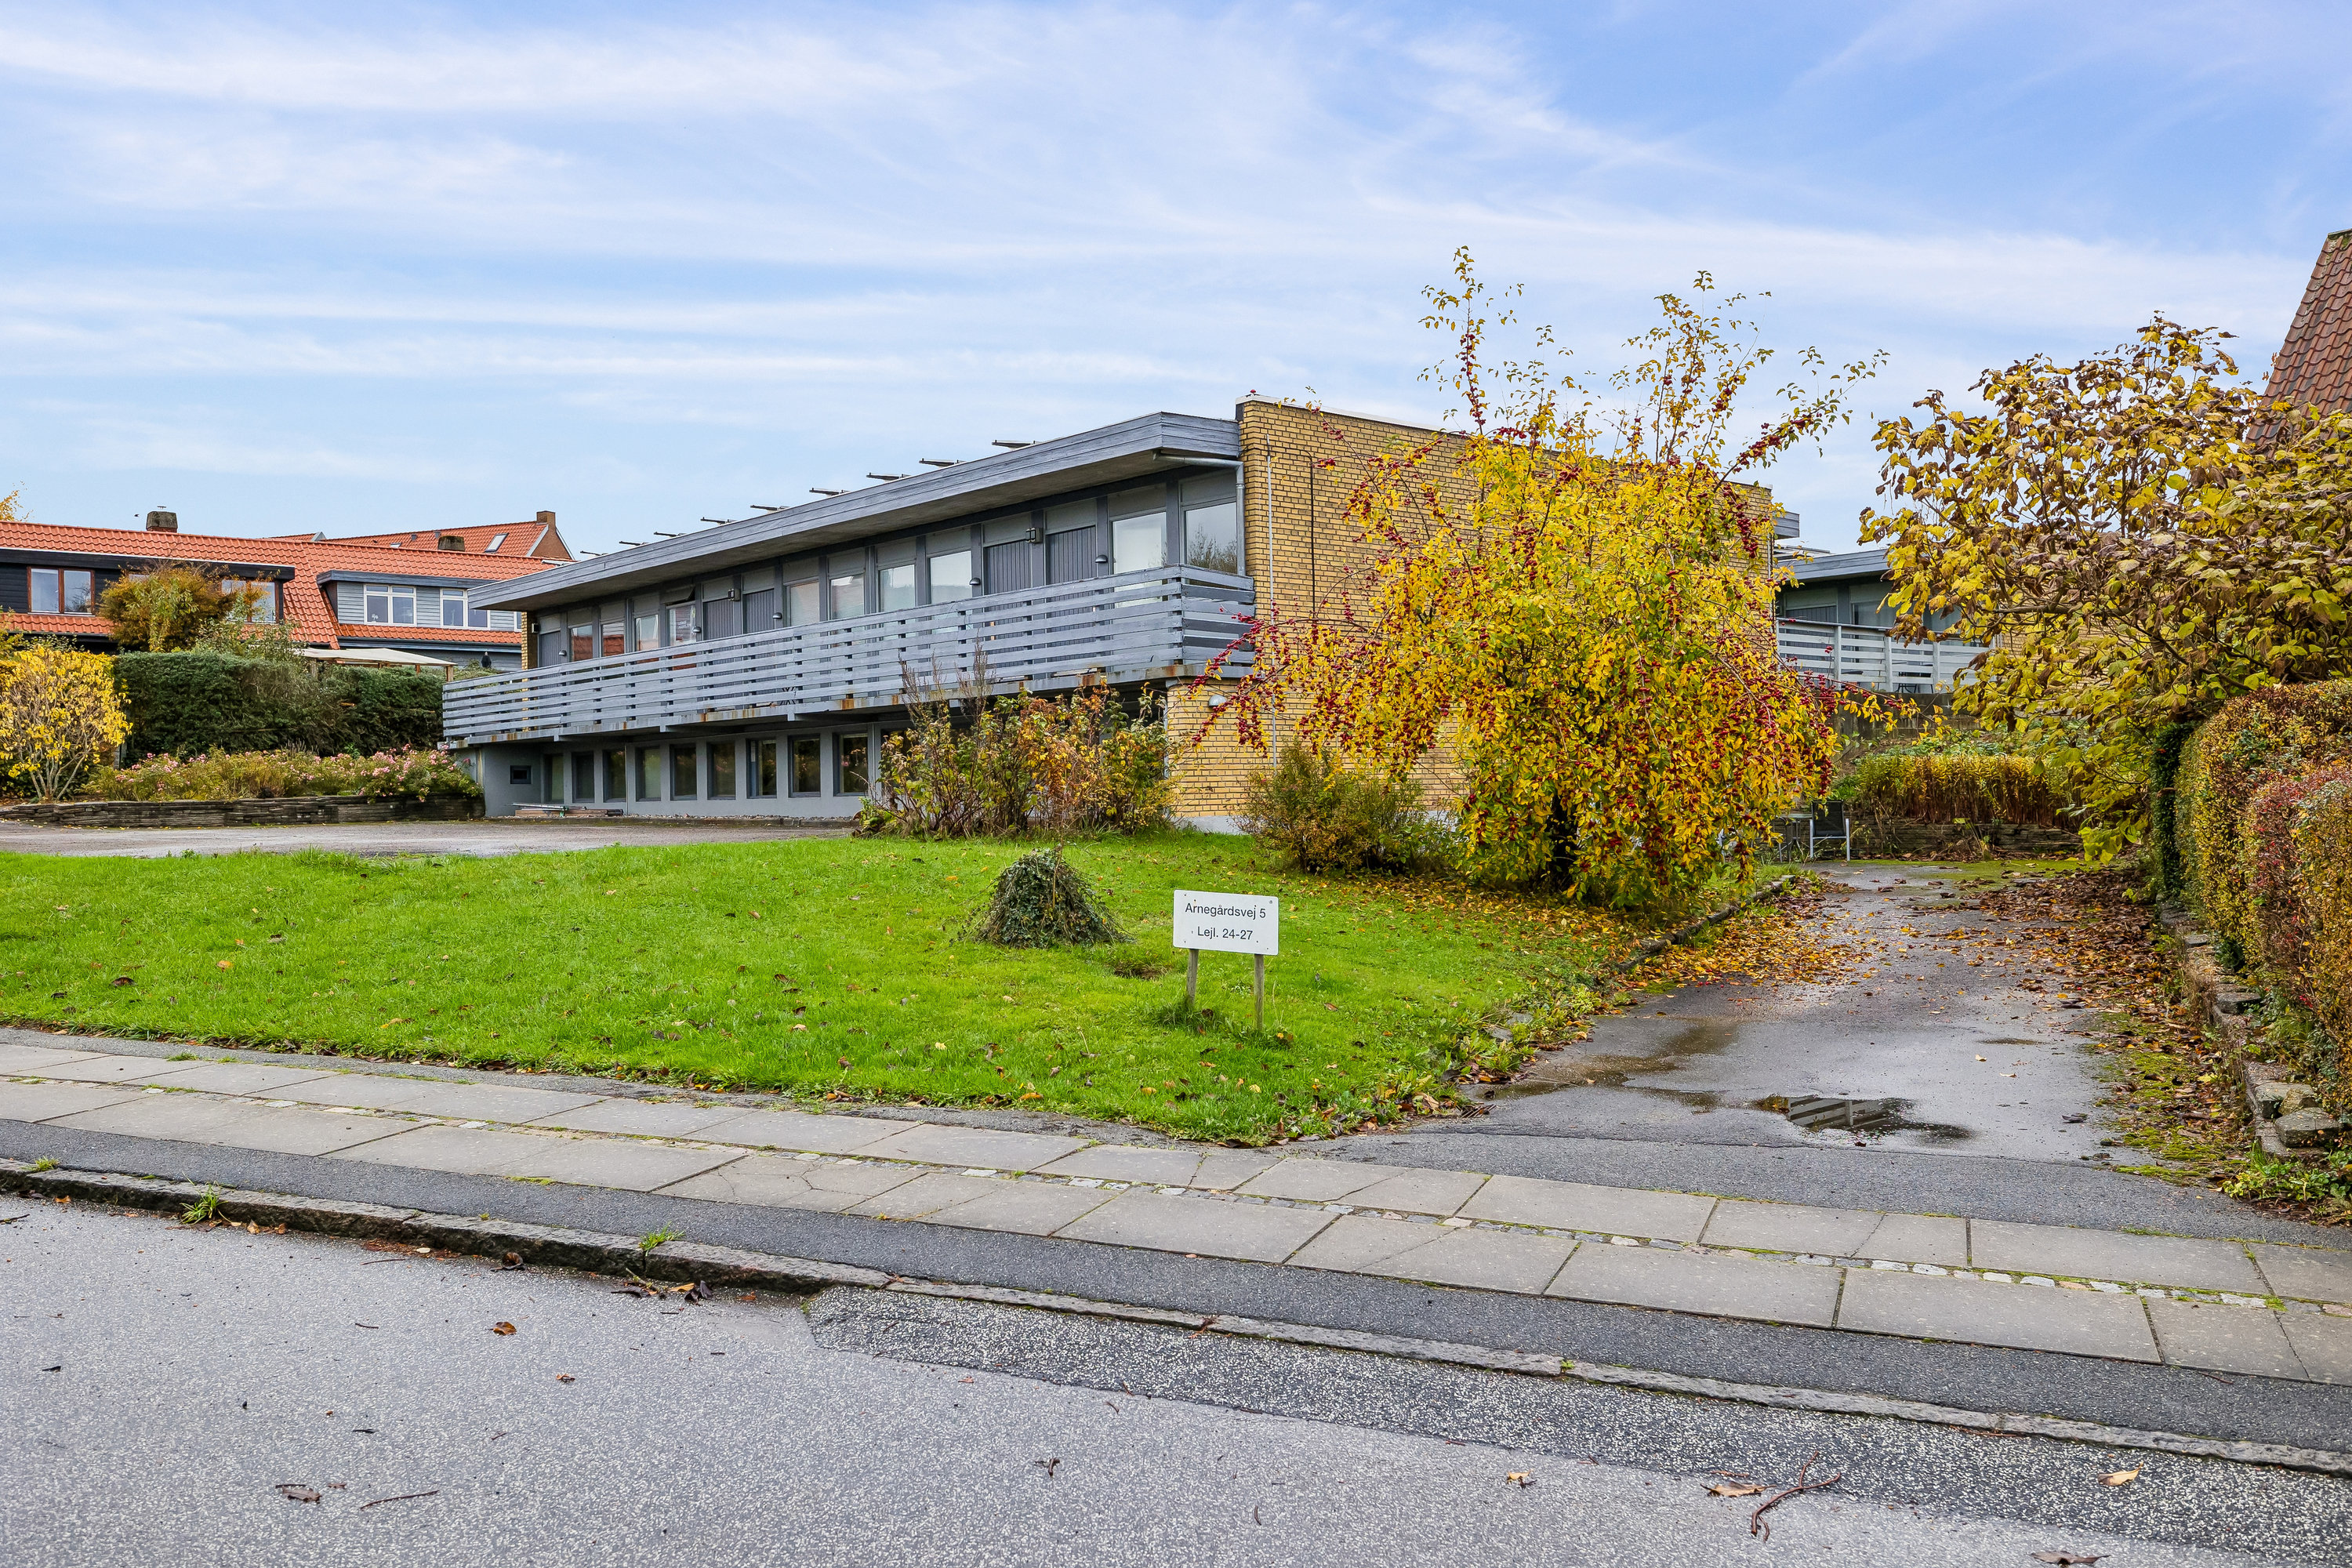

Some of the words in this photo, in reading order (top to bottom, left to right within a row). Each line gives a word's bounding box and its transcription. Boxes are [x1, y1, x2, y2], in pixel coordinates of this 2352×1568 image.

[1185, 902, 1256, 920] Arnegårdsvej
[1259, 908, 1266, 918] 5
[1197, 926, 1219, 939] Lejl.
[1222, 928, 1254, 940] 24-27
